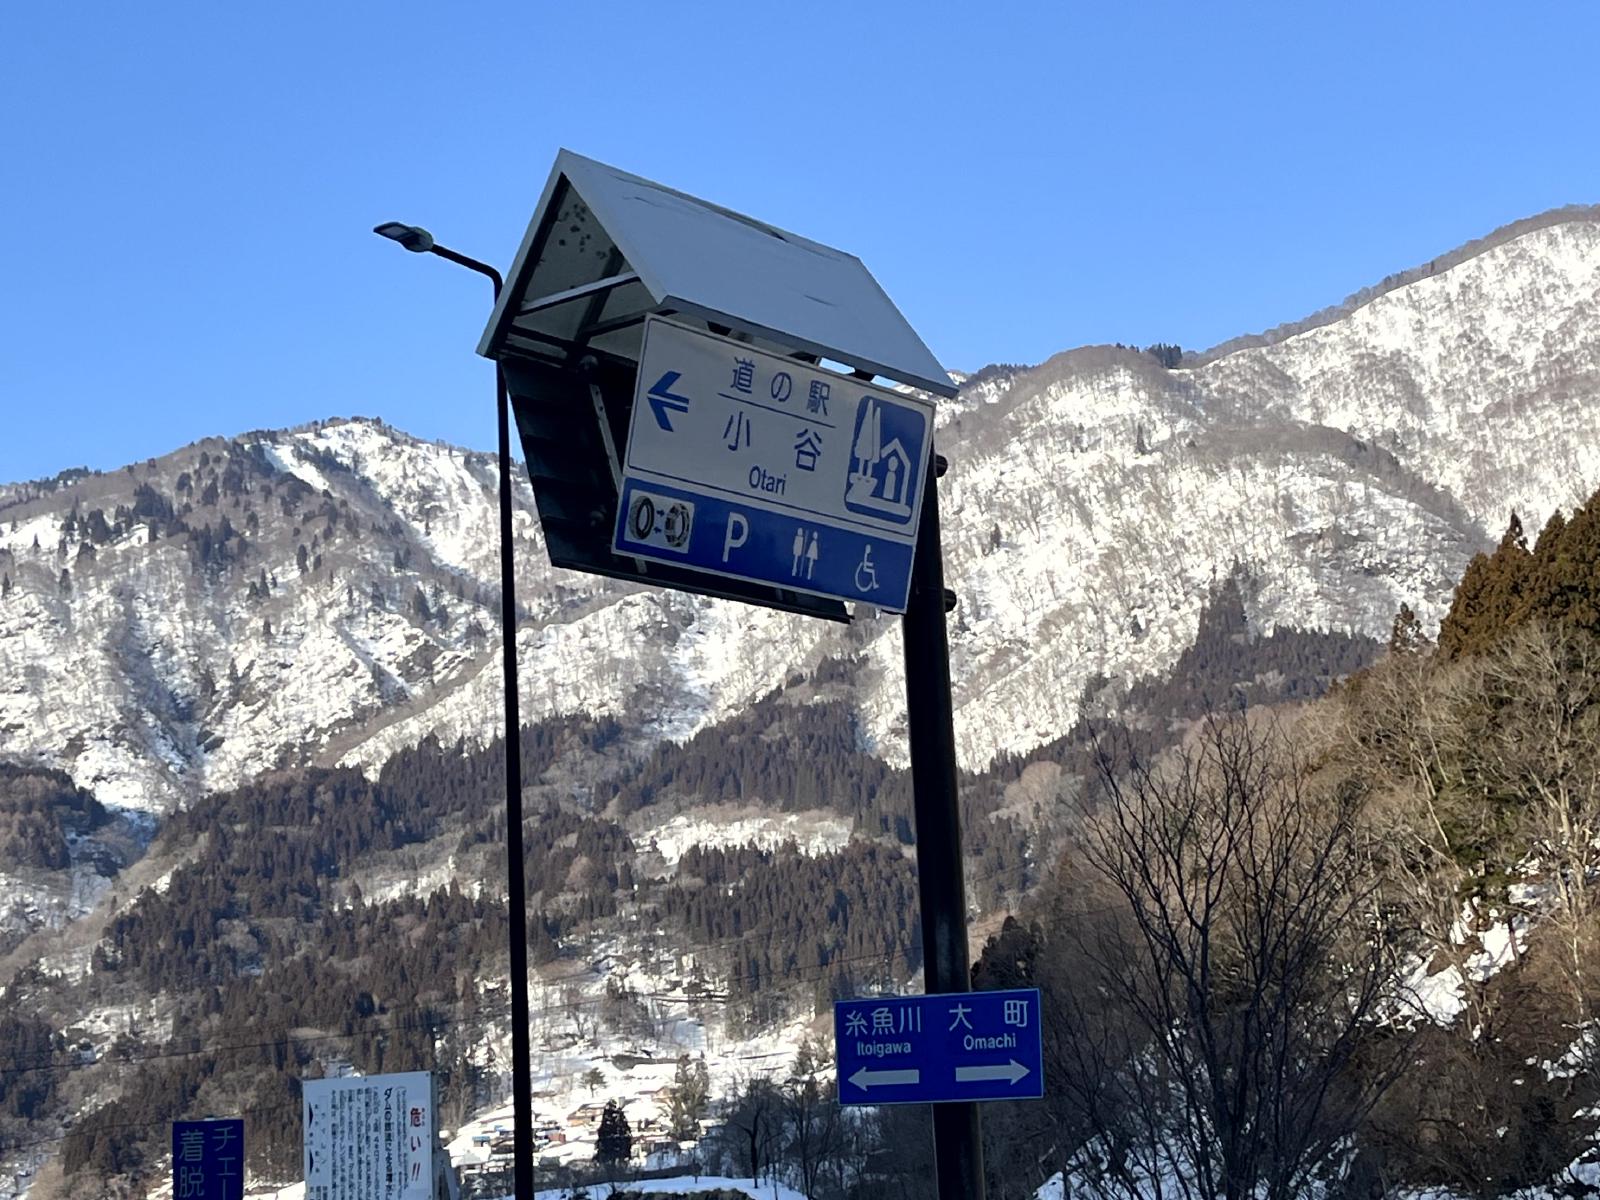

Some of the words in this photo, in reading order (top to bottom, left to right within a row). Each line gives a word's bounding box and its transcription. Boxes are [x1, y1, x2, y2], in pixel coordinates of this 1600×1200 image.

[730, 356, 831, 417] 道の駅
[722, 410, 823, 473] 小谷
[749, 465, 787, 497] Otari
[722, 512, 750, 563] P
[844, 1006, 922, 1038] 糸魚川
[948, 999, 1029, 1033] 大町
[856, 1041, 912, 1058] Itoigawa
[963, 1032, 1017, 1051] Omachi
[179, 1129, 205, 1198] 着脱
